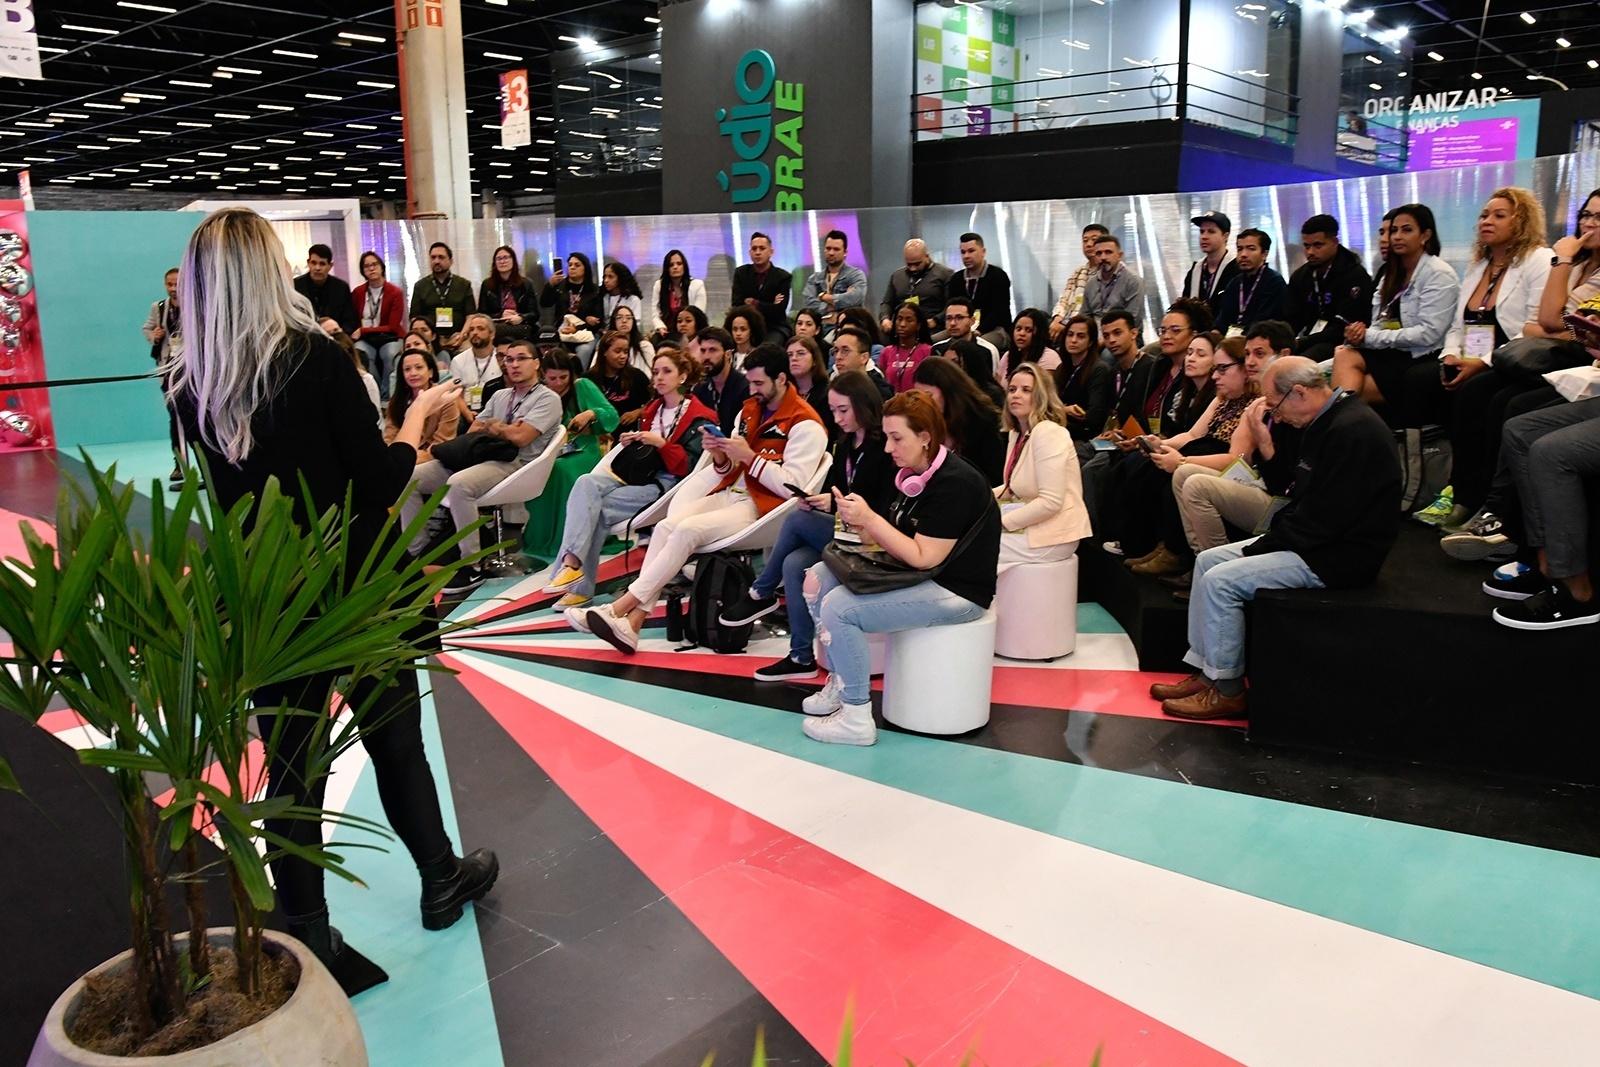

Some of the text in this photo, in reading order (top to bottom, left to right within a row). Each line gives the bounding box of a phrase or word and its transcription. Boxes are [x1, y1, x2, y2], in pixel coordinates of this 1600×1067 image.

[501, 83, 512, 112] RUA
[511, 75, 529, 112] 3
[1396, 115, 1460, 134] FNANÇAS
